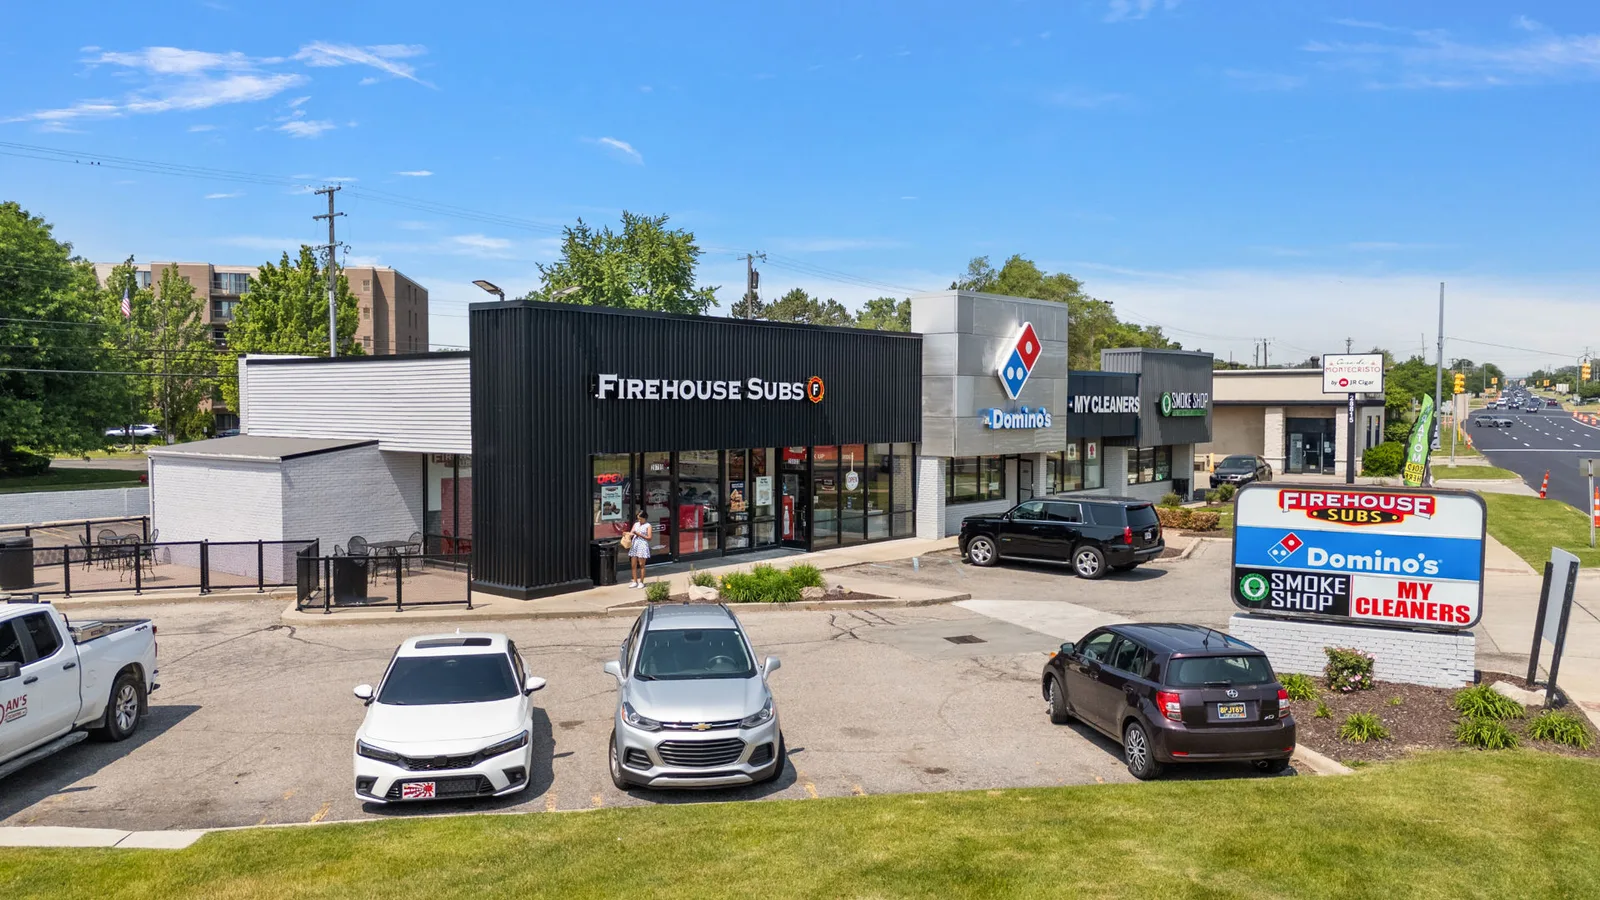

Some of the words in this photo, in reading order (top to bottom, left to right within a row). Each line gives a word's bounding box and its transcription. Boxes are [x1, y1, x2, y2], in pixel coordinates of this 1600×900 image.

[599, 373, 742, 400] FIREHOUSE
[747, 377, 804, 400] SUBS
[1074, 395, 1091, 413] MY
[1091, 395, 1140, 414] CLEANERS
[1171, 392, 1192, 409] SMOKE
[1192, 392, 1209, 409] SHOP
[991, 406, 1052, 429] Domino's
[597, 473, 624, 484] OPEN
[1282, 492, 1432, 520] FIREHOUSE
[1327, 508, 1382, 523] SUBS
[1307, 547, 1439, 575] Domino's
[1271, 573, 1347, 595] SMOKE
[1397, 580, 1434, 601] MY
[1271, 590, 1333, 611] SHOP
[1355, 597, 1470, 624] CLEANERS
